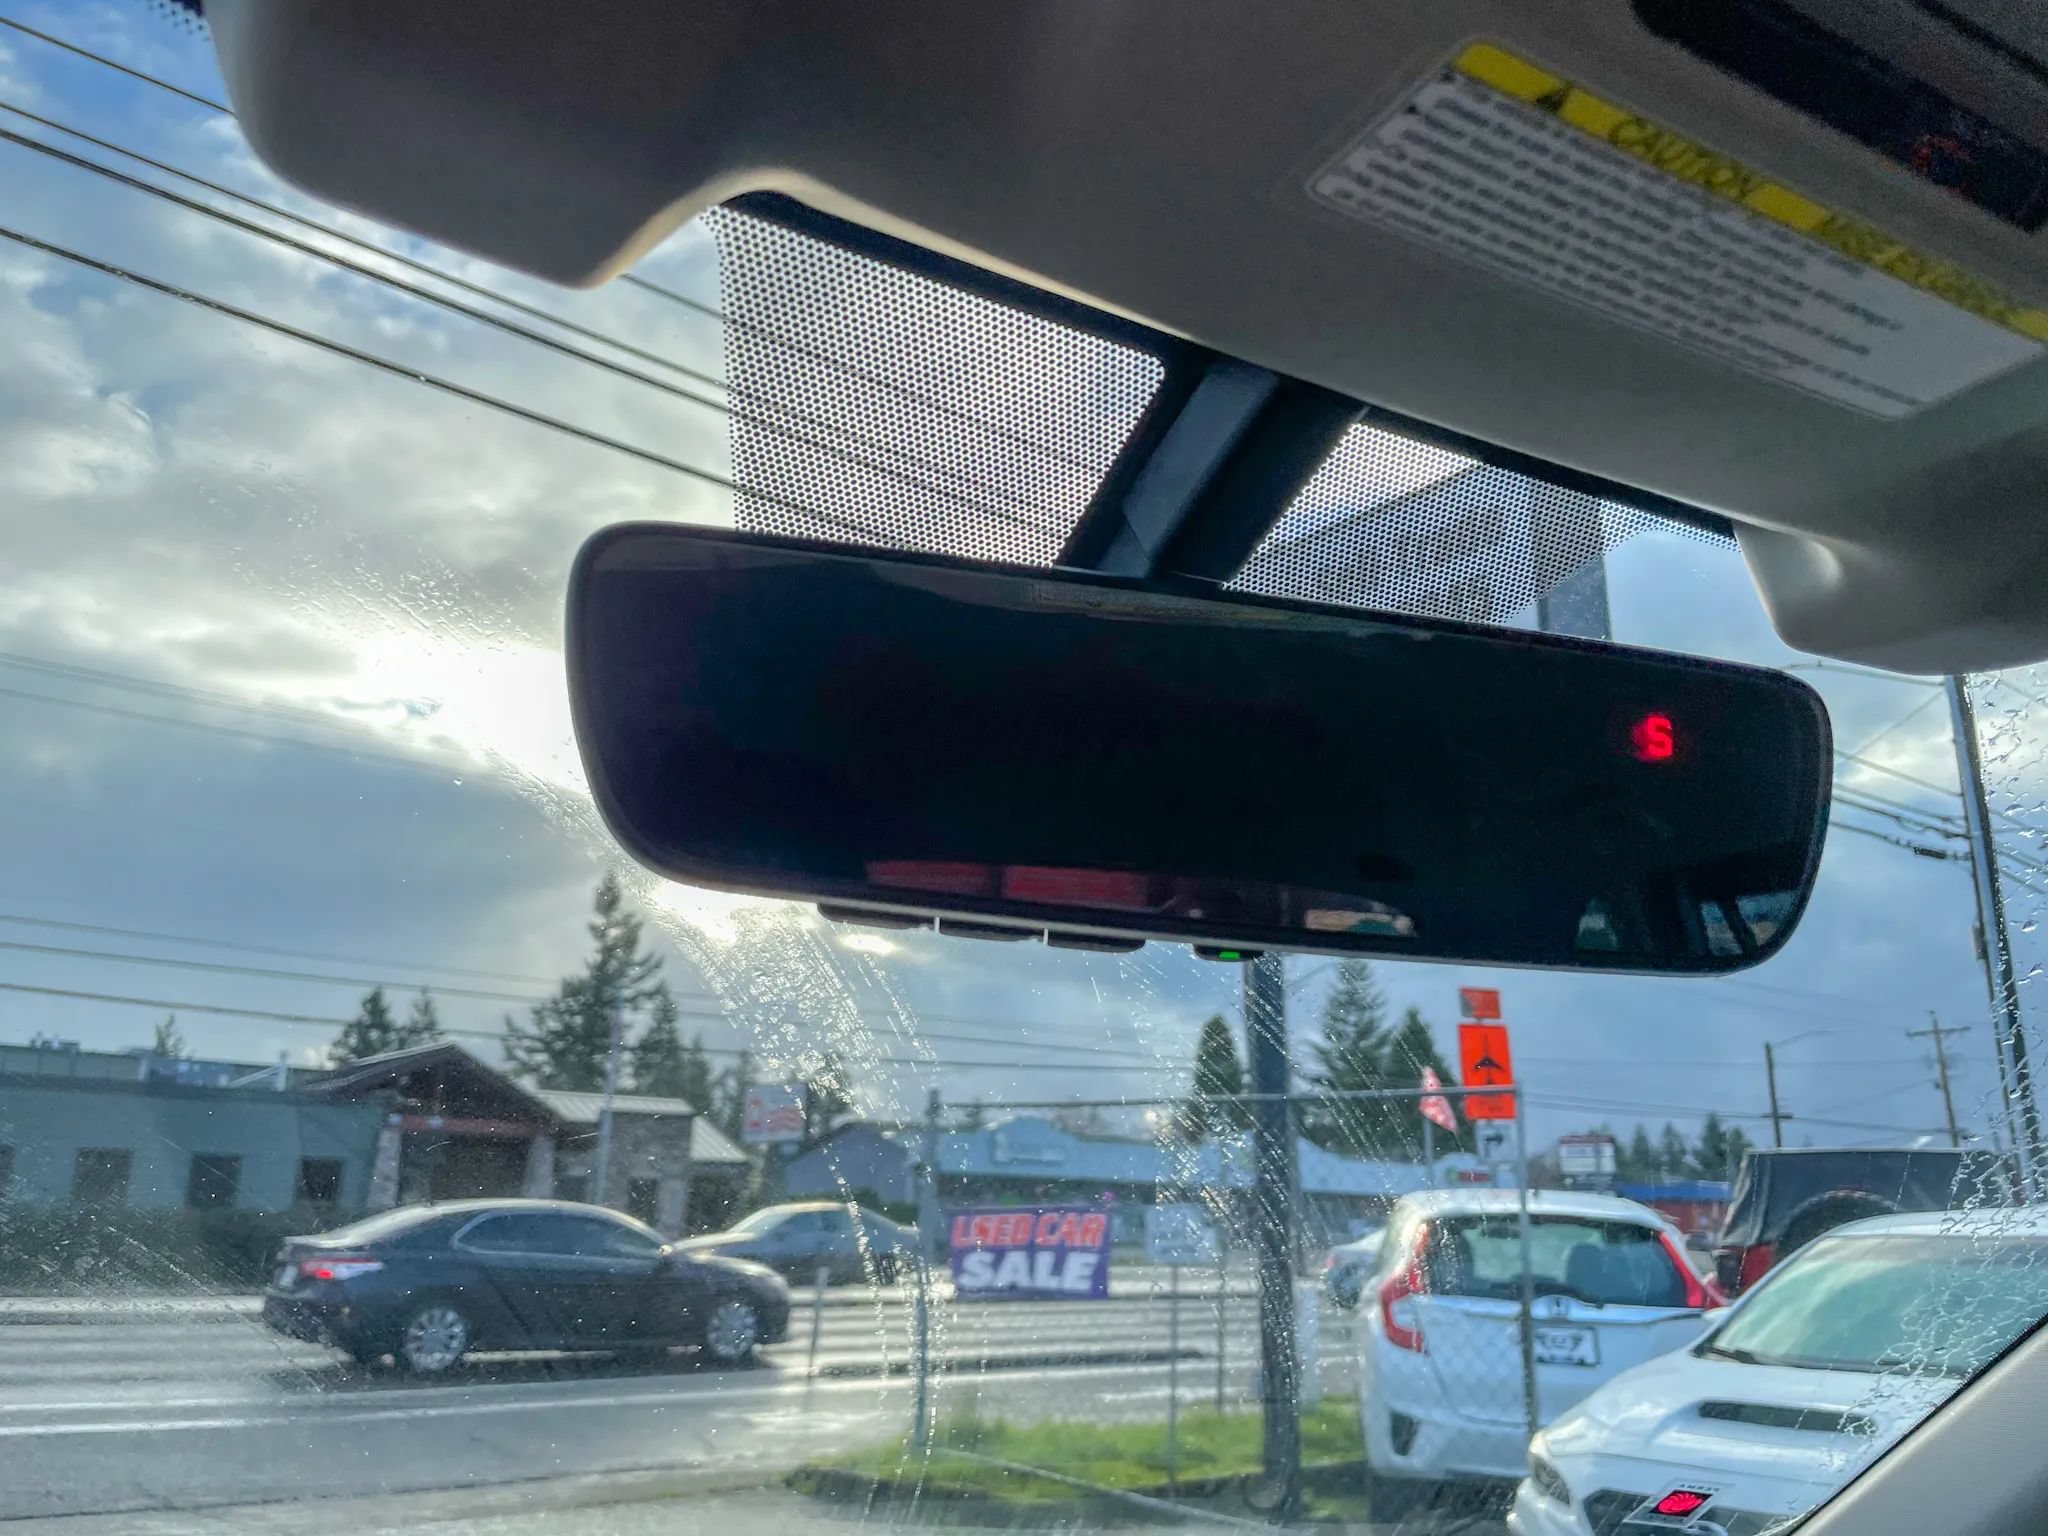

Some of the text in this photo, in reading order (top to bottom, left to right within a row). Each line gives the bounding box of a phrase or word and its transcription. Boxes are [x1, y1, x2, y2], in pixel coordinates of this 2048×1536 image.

[1647, 715, 1673, 757] S
[1035, 1212, 1106, 1246] CAR
[958, 1250, 1099, 1290] SALE
